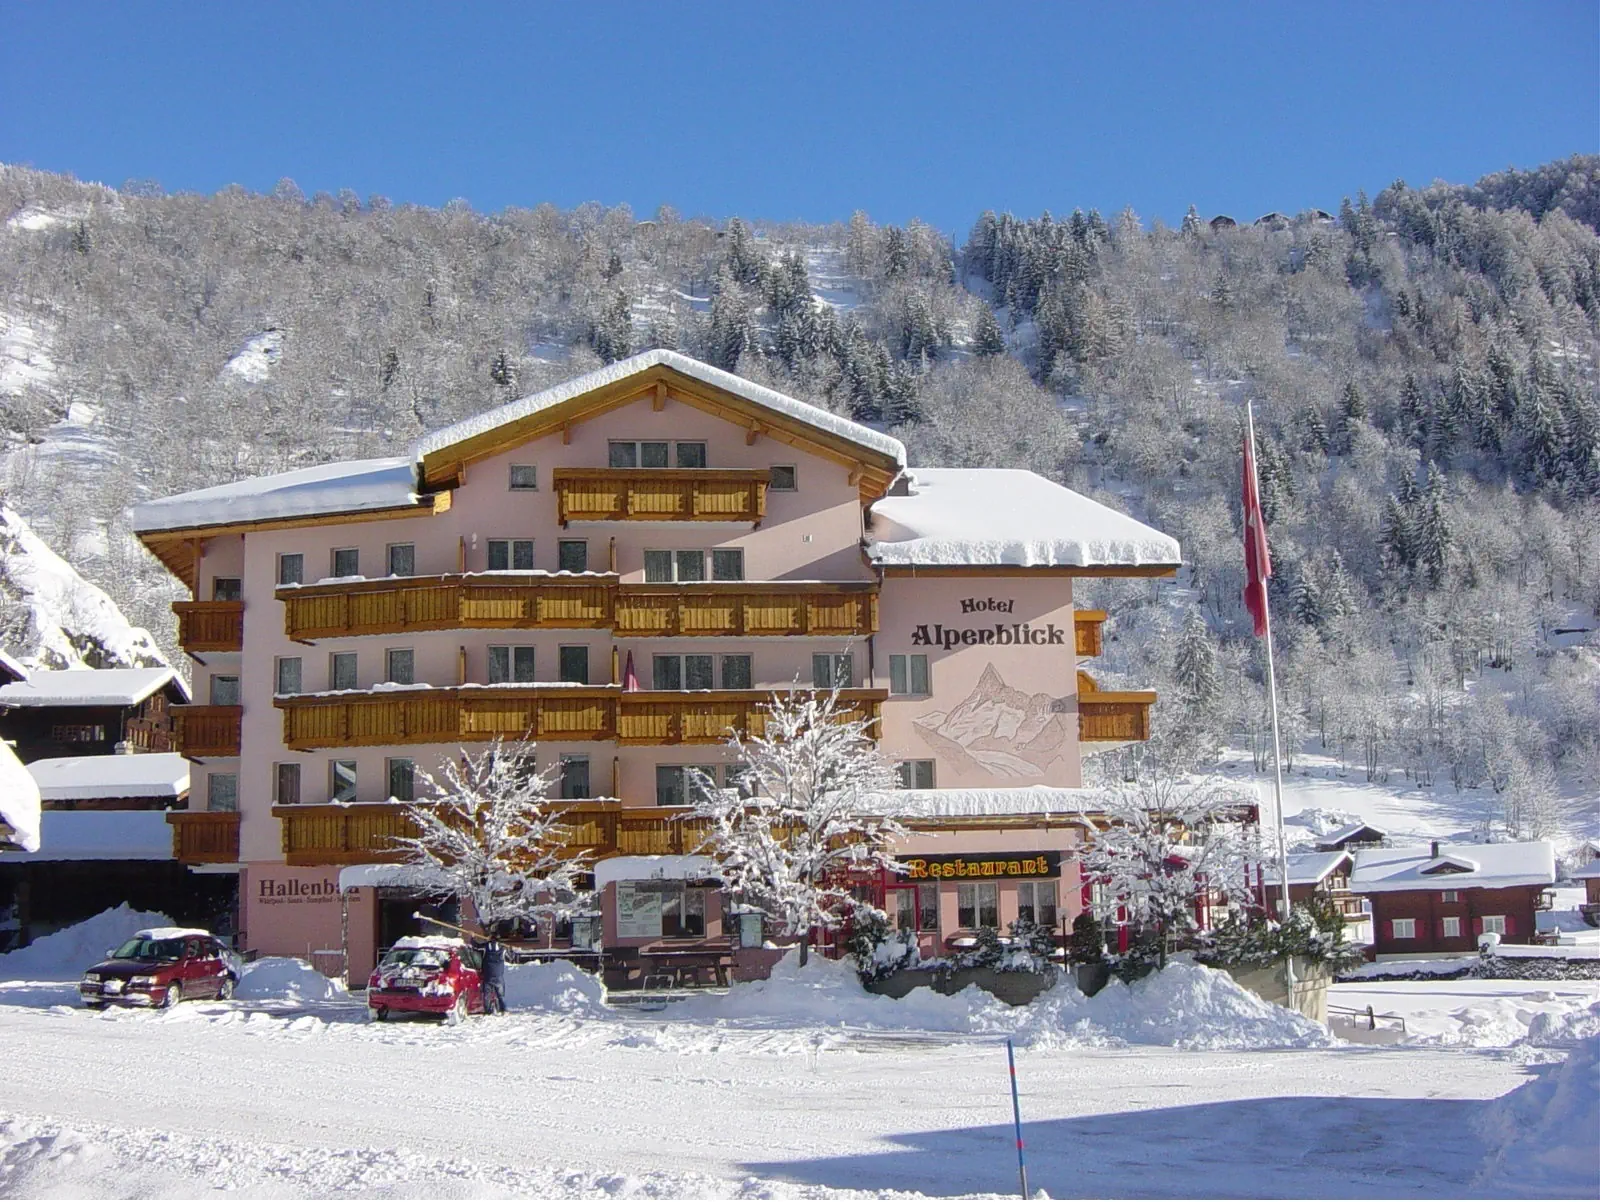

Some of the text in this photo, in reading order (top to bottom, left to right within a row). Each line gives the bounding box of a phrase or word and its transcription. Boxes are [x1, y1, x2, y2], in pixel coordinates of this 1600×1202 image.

[960, 597, 1014, 613] Hotel
[911, 623, 1065, 650] Alpenblick
[907, 856, 1049, 878] Restaurant
